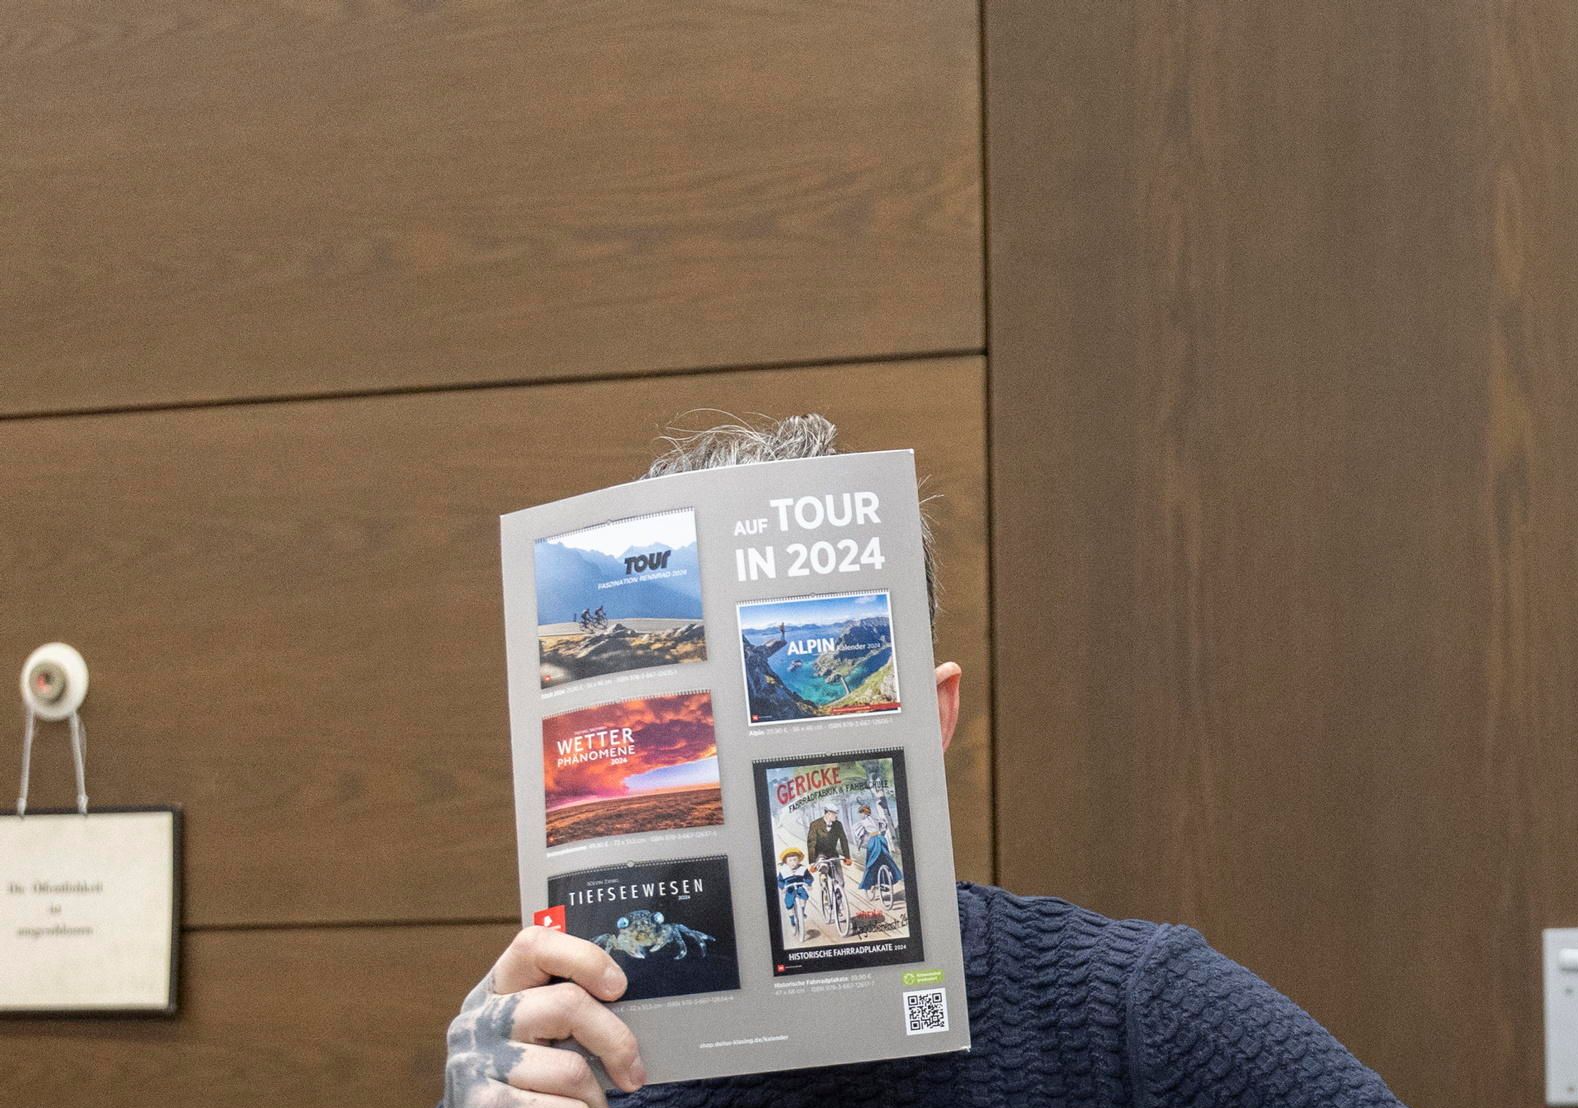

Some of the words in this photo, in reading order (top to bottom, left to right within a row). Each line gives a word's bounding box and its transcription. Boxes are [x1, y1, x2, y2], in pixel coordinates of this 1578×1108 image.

[734, 518, 768, 536] AUF
[769, 491, 881, 532] TOUR
[735, 546, 776, 582] IN
[786, 536, 886, 577] 2024
[787, 638, 835, 656] ALPIN
[557, 727, 635, 756] WETTER
[557, 745, 636, 768] PHÄNOMENE
[610, 757, 629, 766] 2024
[776, 767, 842, 805] GERICKE
[569, 878, 703, 906] TIEFSEEWESEN
[788, 949, 833, 961] HISTORISCHE
[833, 943, 893, 957] FAHRRADPLAKATE
